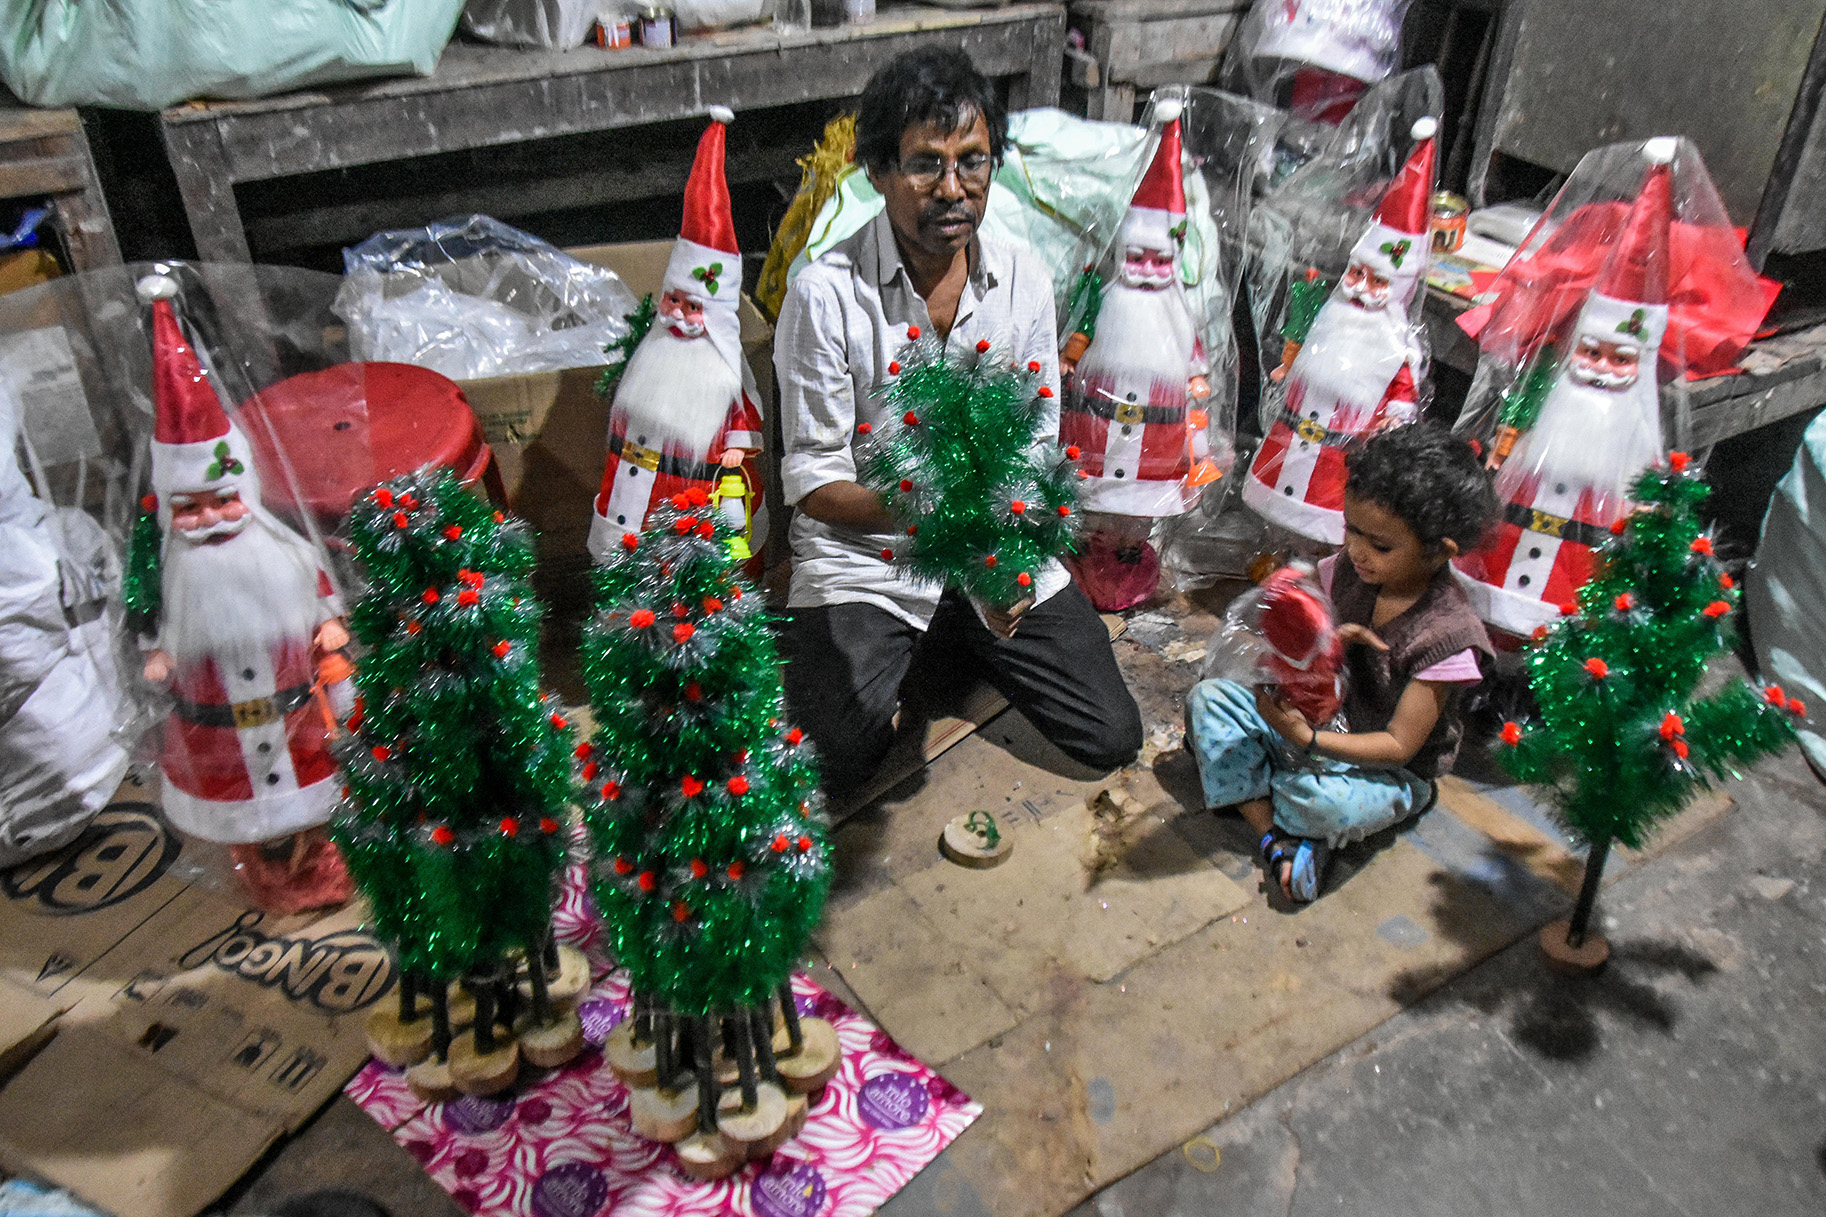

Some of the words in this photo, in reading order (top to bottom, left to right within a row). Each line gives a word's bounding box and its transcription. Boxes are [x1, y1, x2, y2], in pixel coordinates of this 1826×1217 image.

[182, 911, 398, 1013] BINGO!
[869, 1087, 912, 1123] amore
[884, 1082, 912, 1109] mio
